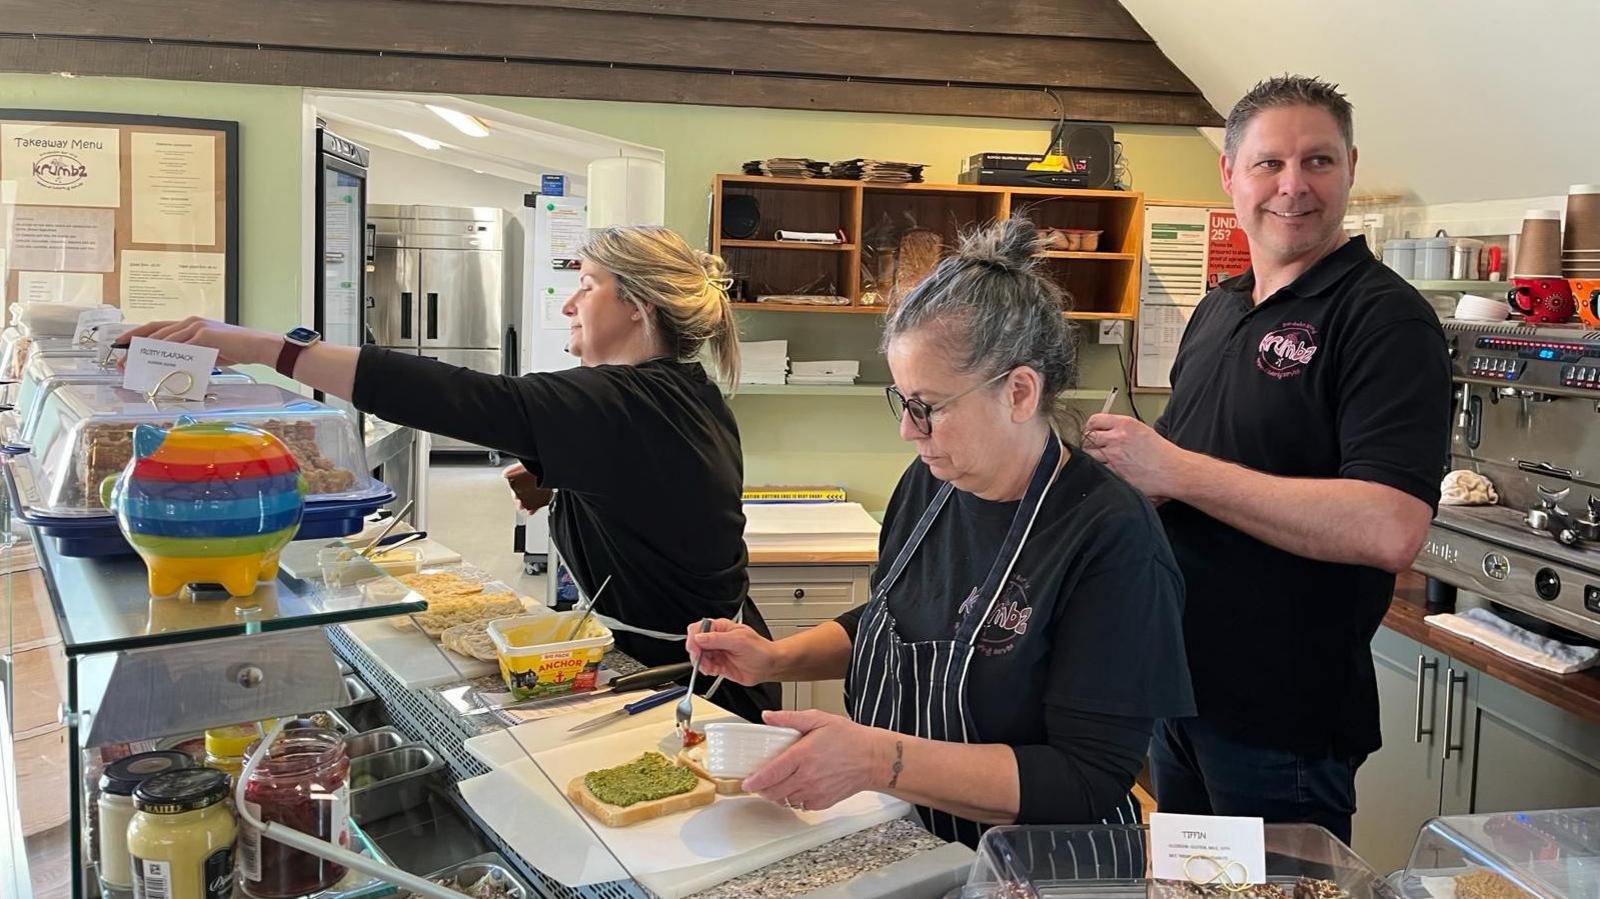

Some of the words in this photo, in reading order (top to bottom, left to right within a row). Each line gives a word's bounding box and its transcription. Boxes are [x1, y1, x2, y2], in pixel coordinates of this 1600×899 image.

[14, 137, 68, 148] Takeaway
[71, 139, 103, 150] Menu
[1212, 217, 1240, 228] UND
[1211, 229, 1231, 240] 25?
[538, 660, 582, 671] ANCHOR
[144, 804, 183, 813] MAILLE
